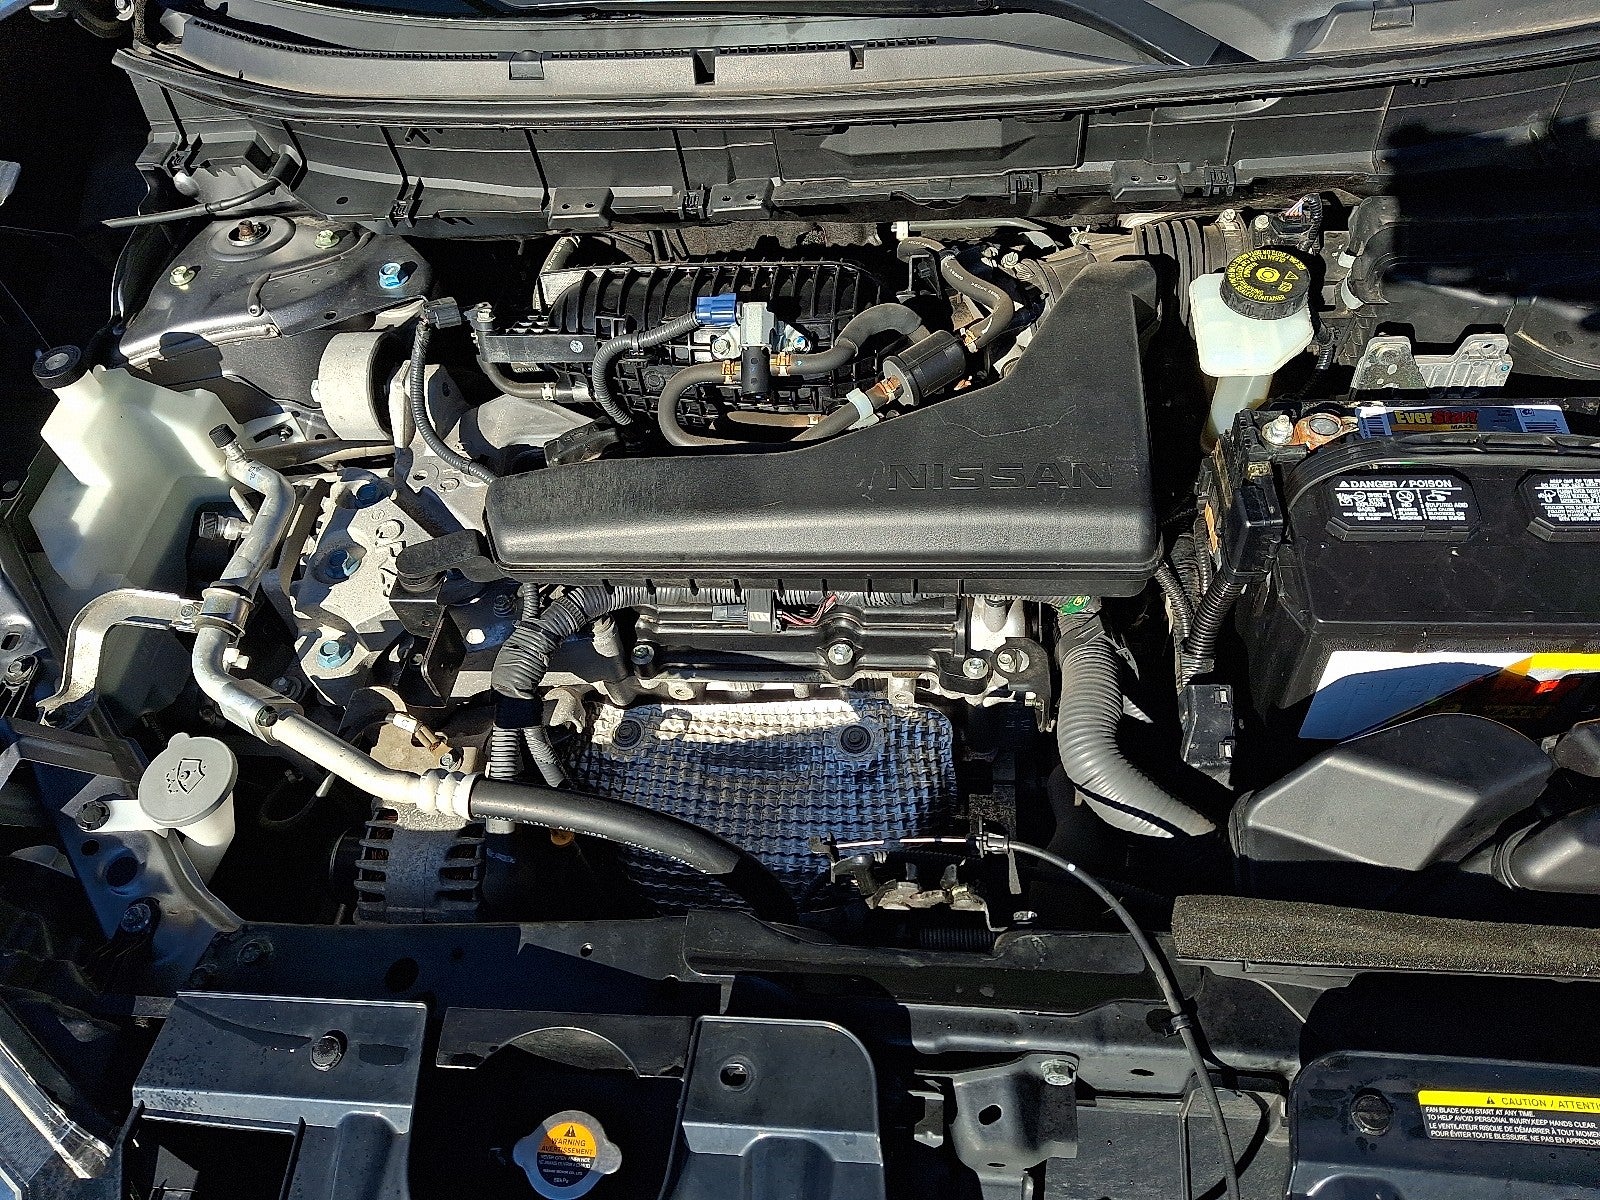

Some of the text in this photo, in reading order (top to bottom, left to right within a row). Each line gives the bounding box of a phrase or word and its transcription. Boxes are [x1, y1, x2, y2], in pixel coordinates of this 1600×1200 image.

[888, 462, 1112, 490] NISSAN
[1350, 480, 1397, 488] DANGER
[1409, 479, 1452, 488] POISON
[1501, 1097, 1546, 1107] CAUTION
[1558, 1100, 1600, 1110] ATTENTI
[1473, 1131, 1492, 1139] TOUTE
[551, 1138, 586, 1147] WARNING
[541, 1145, 593, 1155] AVERTISSEMENT
